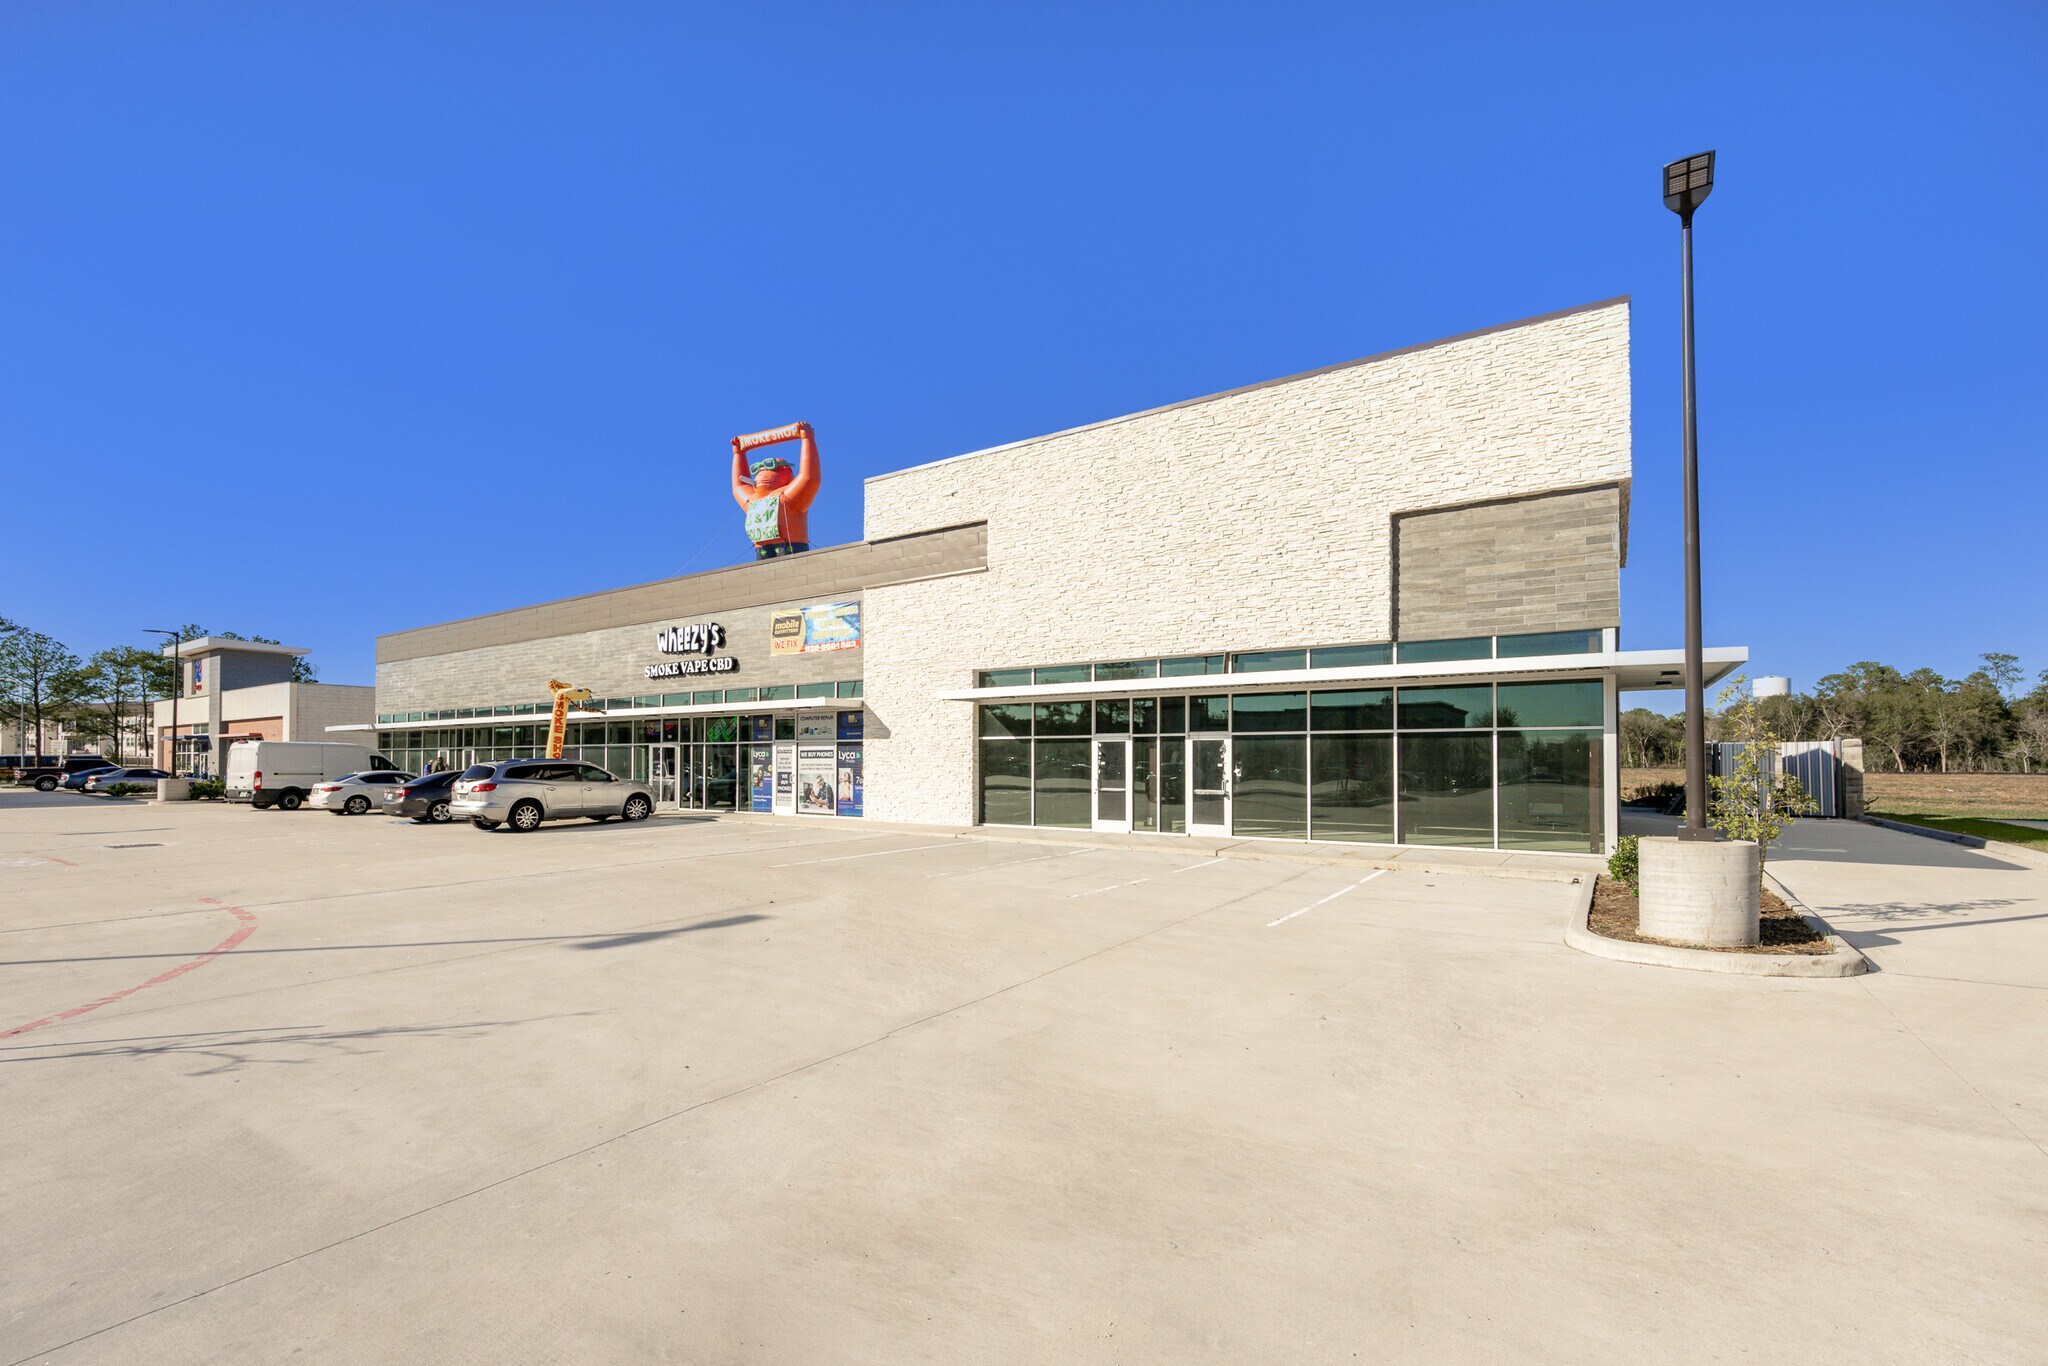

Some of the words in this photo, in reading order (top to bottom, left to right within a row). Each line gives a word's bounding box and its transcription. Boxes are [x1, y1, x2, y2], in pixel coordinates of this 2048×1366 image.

[740, 432, 770, 449] SMOKE
[772, 424, 798, 440] SHOP
[775, 618, 800, 630] mobile
[774, 640, 785, 650] WE
[786, 639, 798, 648] FIX
[644, 663, 680, 677] SMOKE
[680, 659, 709, 673] VAPE
[709, 657, 733, 671] CBD
[554, 692, 565, 734] SMOKE
[553, 735, 563, 759] SHO
[838, 750, 856, 761] Lyca
